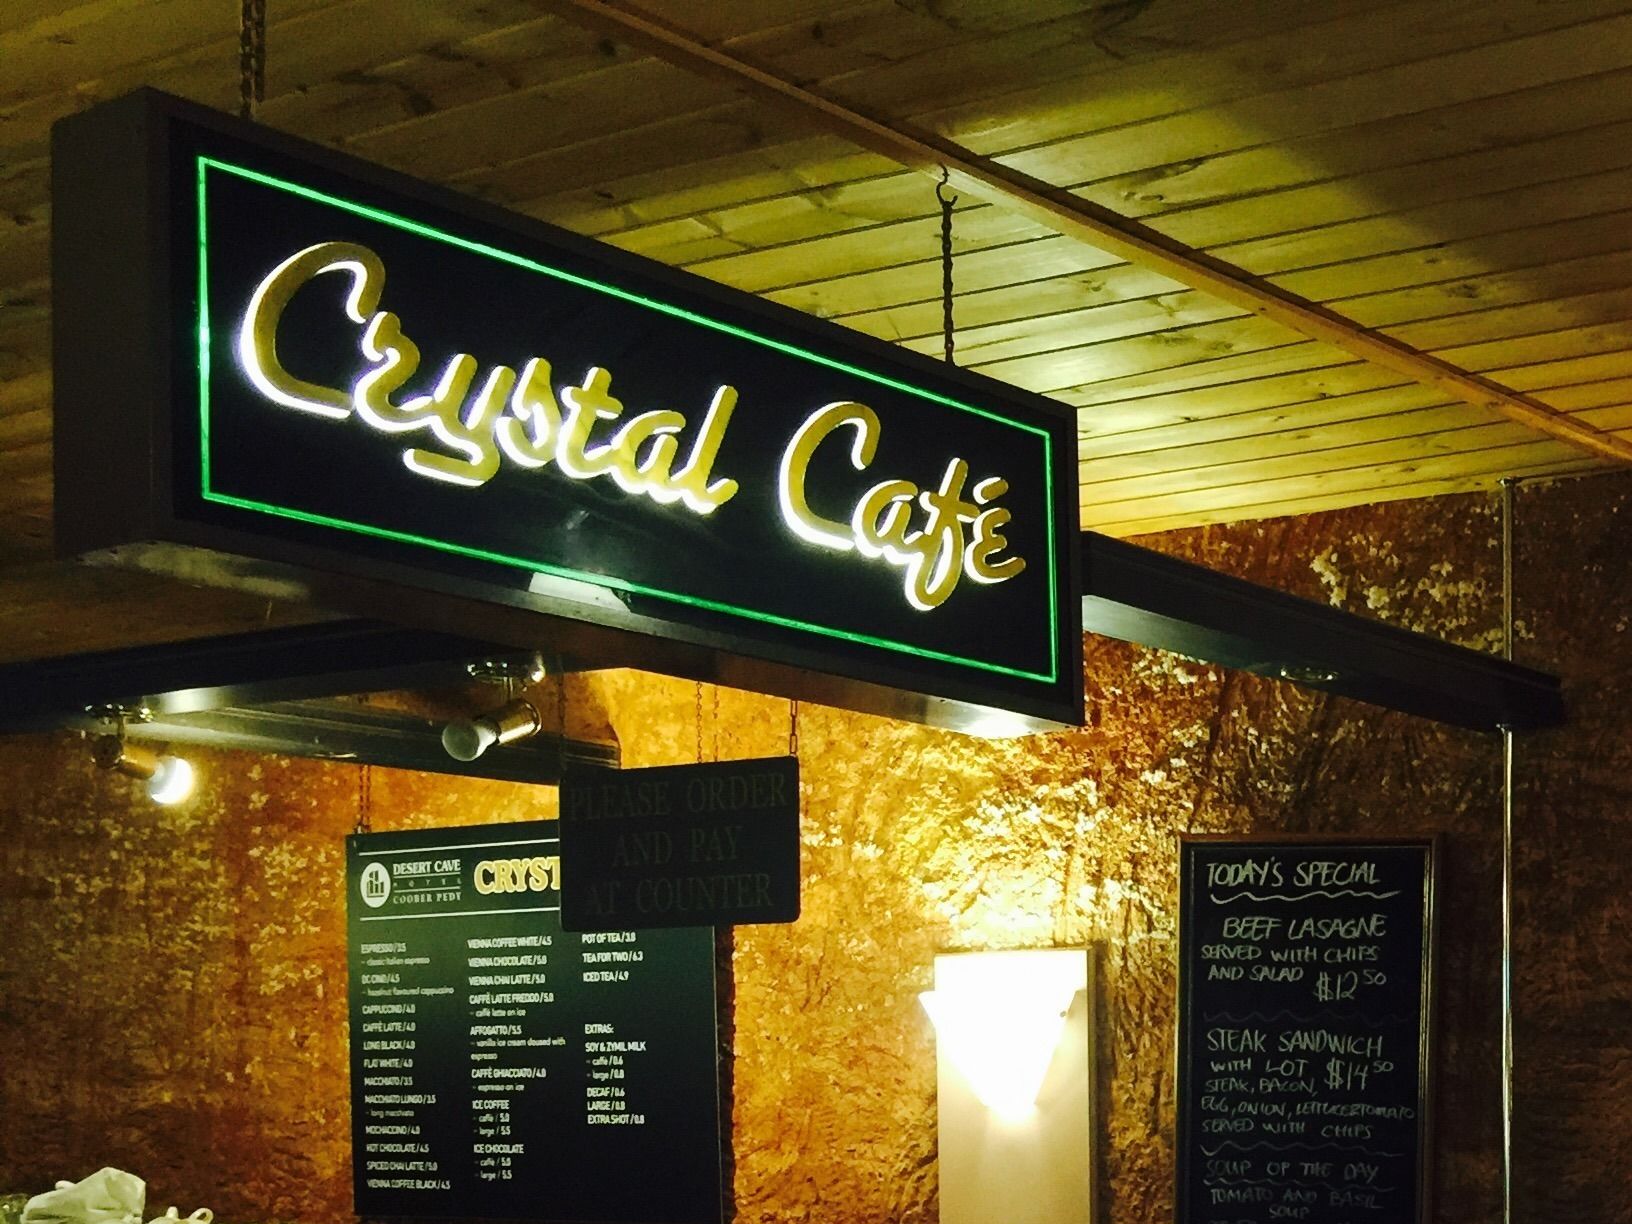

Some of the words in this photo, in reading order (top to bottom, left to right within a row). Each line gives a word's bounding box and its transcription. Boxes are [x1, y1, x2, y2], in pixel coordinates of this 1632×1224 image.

[238, 241, 739, 514] Crystal
[780, 401, 1025, 611] Café
[570, 781, 671, 821] PLEASE
[688, 773, 785, 814] ORDER
[612, 831, 673, 867] AND
[689, 826, 742, 862] PAY
[393, 862, 432, 876] DESERT
[434, 859, 461, 873] CAVE
[1206, 855, 1284, 888] TODAY'S
[1293, 860, 1381, 888] SPECIAL
[436, 891, 462, 902] PEDY
[636, 874, 774, 913] COUNTER
[1222, 916, 1282, 941] BEEF
[1287, 913, 1388, 941] LASAGNE
[582, 933, 597, 944] POT
[597, 933, 607, 944] OF
[607, 932, 621, 943] TEA
[582, 952, 597, 963] TEA
[597, 952, 611, 963] FOR
[611, 951, 628, 962] TWO
[1200, 943, 1262, 961] SERVED
[1271, 945, 1317, 963] WITH
[1323, 946, 1380, 963] CHIPS
[583, 971, 600, 982] ICED
[600, 971, 615, 982] TEA
[1207, 963, 1244, 981] AND
[1250, 965, 1304, 983] SALAD
[585, 1041, 599, 1052] SOY
[606, 1041, 627, 1051] ZYMIL
[627, 1041, 647, 1051] MILK
[1206, 1027, 1267, 1053] STEAK
[1277, 1028, 1383, 1058] SANDWICH
[1210, 1056, 1251, 1073] WITH
[1265, 1058, 1308, 1077] LOT
[587, 1087, 610, 1097] DECAF
[472, 1100, 484, 1110] ICE
[484, 1100, 510, 1110] COFFEE
[587, 1101, 611, 1111] LARGE
[588, 1114, 611, 1125] EXTRA
[611, 1114, 629, 1124] SHOT
[1201, 1118, 1255, 1134] SERVED
[1262, 1120, 1305, 1134] WITH
[1320, 1124, 1373, 1139] CHIPS
[473, 1144, 485, 1154] ICE
[1207, 1159, 1252, 1178] SOUP
[1295, 1162, 1334, 1178] THE
[1343, 1163, 1379, 1185] DAY
[1211, 1187, 1274, 1205] TOMATO
[1282, 1189, 1318, 1203] AND
[1328, 1191, 1384, 1209] BASIL
[1268, 1206, 1310, 1220] SOUP
